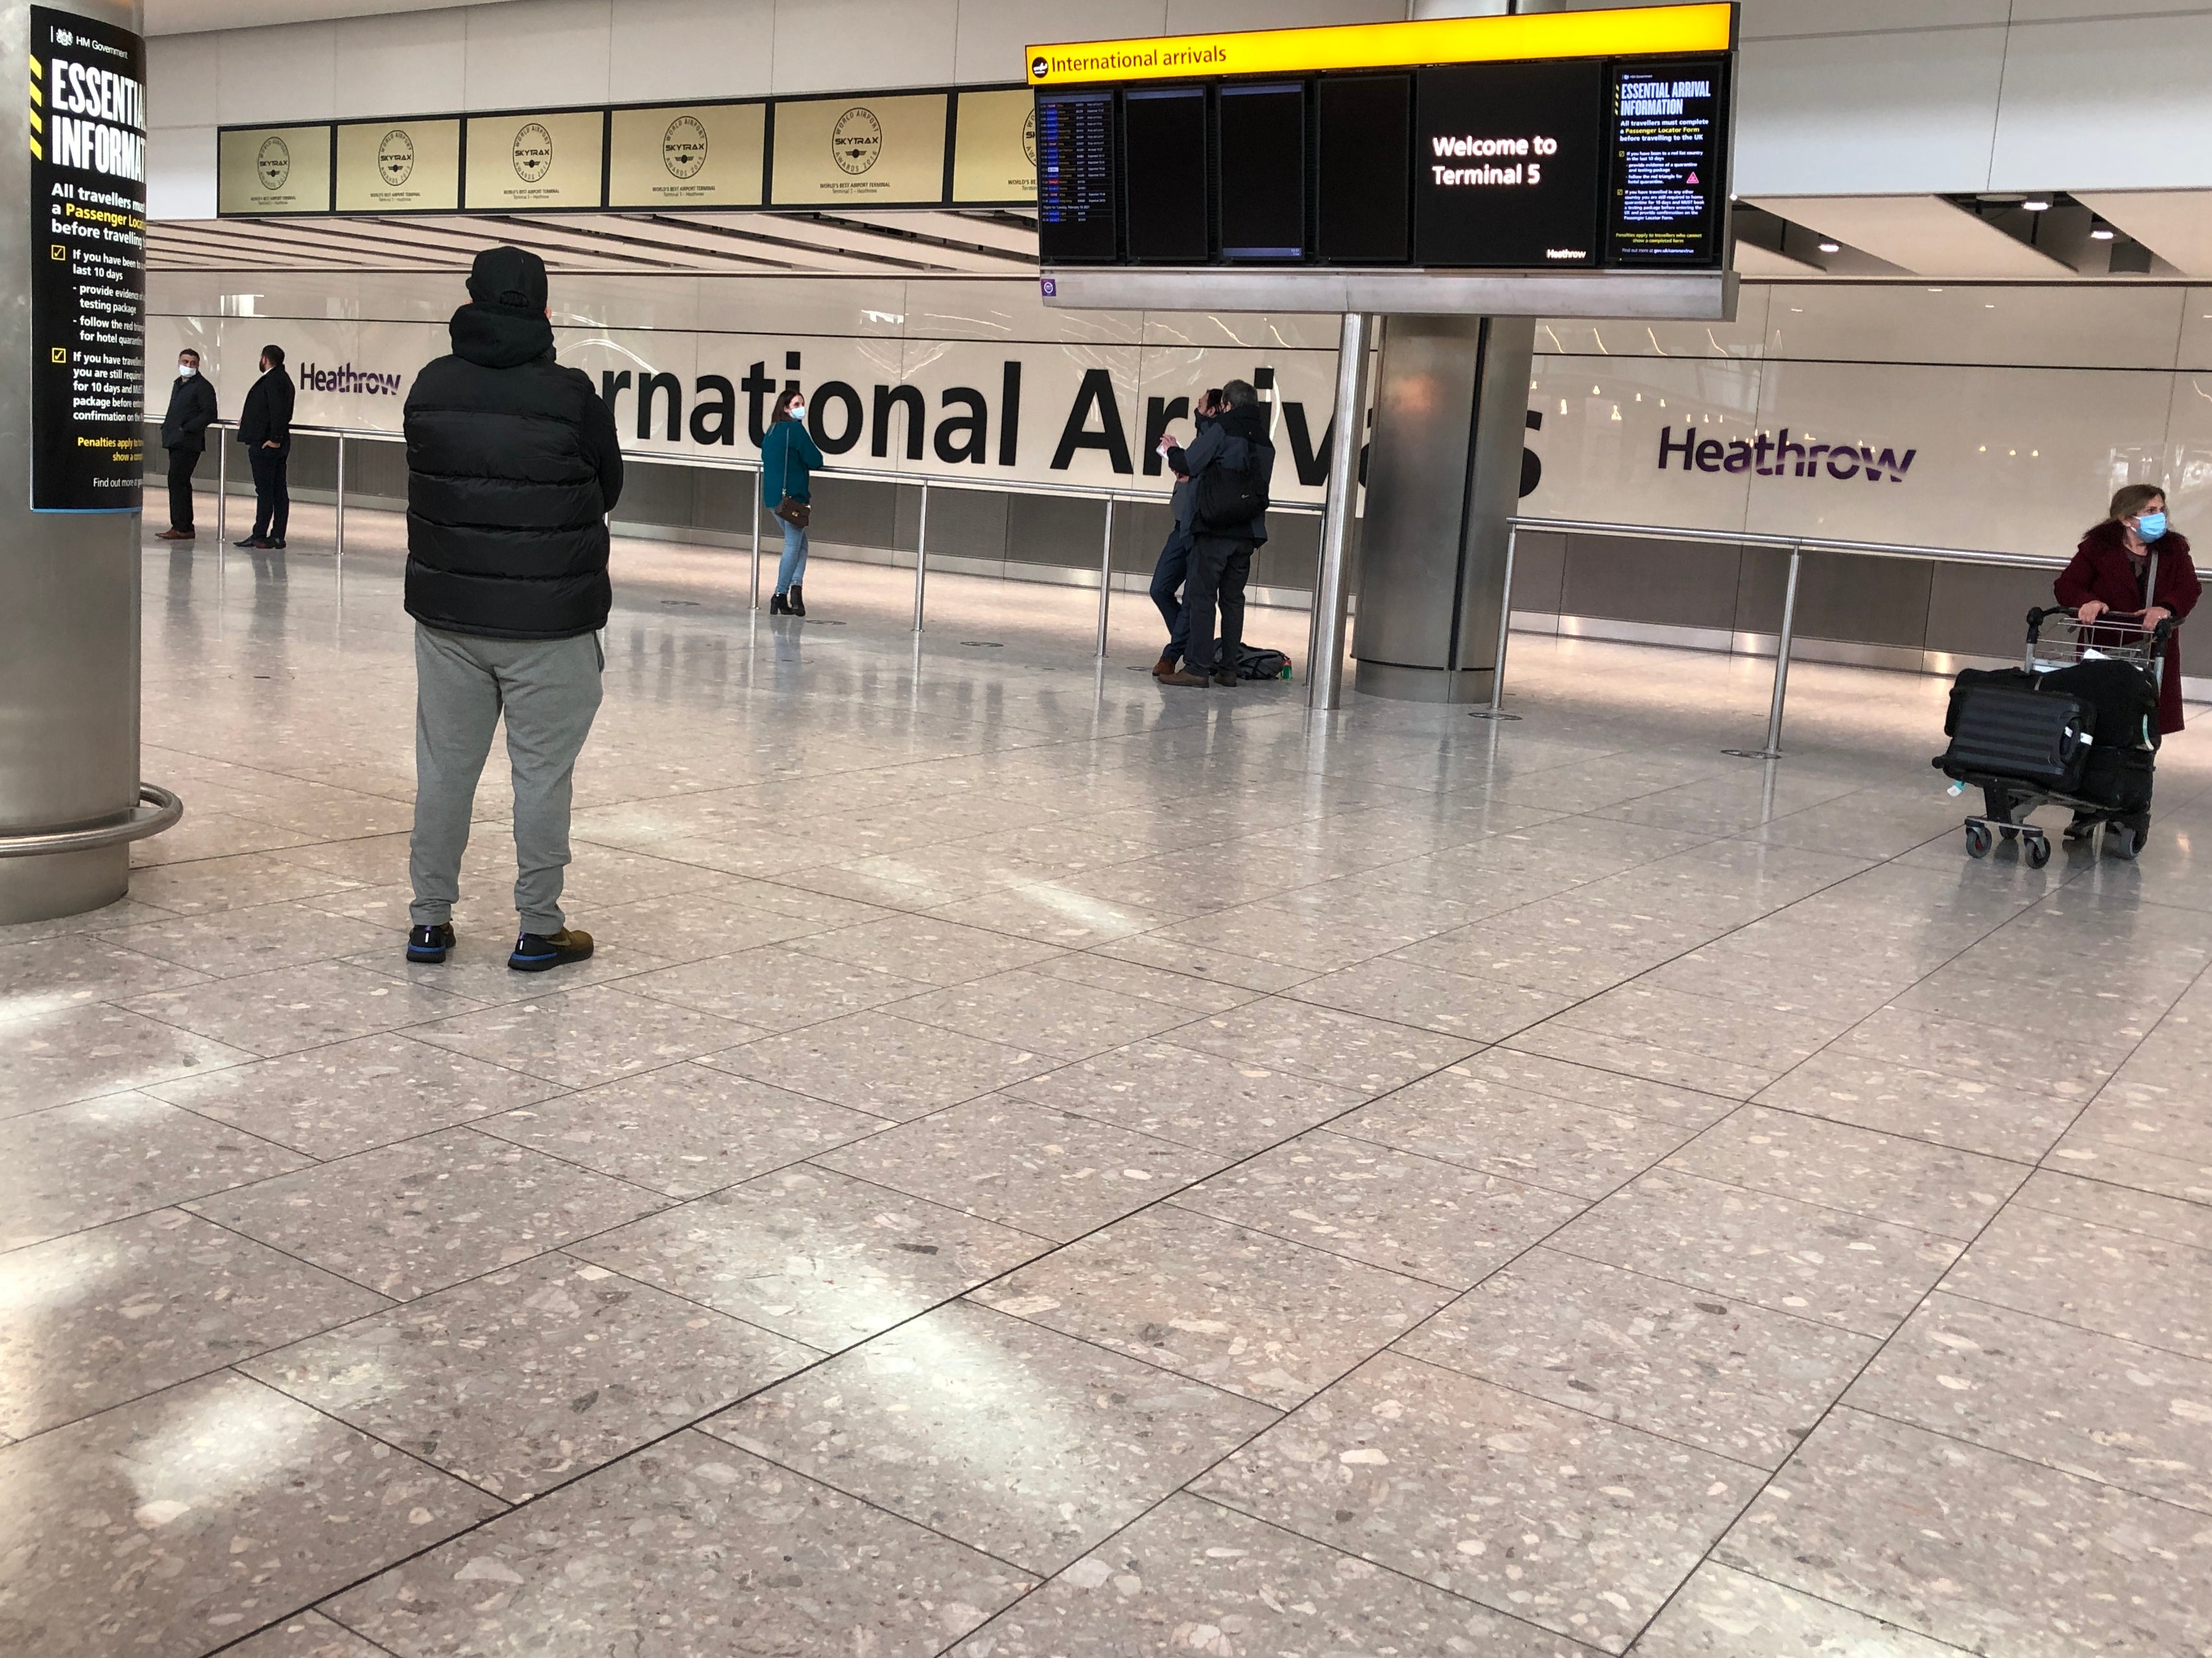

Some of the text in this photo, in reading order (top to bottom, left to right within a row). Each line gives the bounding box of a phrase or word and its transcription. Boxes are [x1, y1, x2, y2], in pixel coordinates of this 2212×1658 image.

[76, 36, 128, 59] HM Government
[1052, 45, 1227, 72] International arrivals
[1621, 80, 1711, 99] ESSENTIAL ARRIVAL
[1621, 99, 1683, 115] INFORMATION
[667, 119, 704, 141] WORLD AIRPORT
[836, 111, 879, 135] WORLD AIRPORT
[1432, 136, 1557, 156] Welcome to
[667, 157, 687, 176] AWARDS
[835, 152, 859, 172] AWARDS
[1432, 163, 1540, 185] Terminal 5
[51, 183, 73, 198] All
[78, 187, 131, 210] travellers
[52, 204, 61, 215] a
[66, 203, 127, 227] Passenger
[52, 218, 143, 250] before travelling
[73, 249, 81, 259] If
[83, 252, 101, 263] you
[103, 253, 121, 265] have
[123, 256, 136, 269] been
[1547, 248, 1586, 258] Heathrow
[73, 263, 123, 282] last 10 days
[80, 285, 113, 296] provide
[115, 289, 139, 300] evidence
[80, 298, 111, 313] testing
[80, 315, 110, 328] follow
[111, 319, 123, 330] the
[124, 322, 133, 331] red
[80, 330, 95, 341] for
[97, 331, 117, 343] hotel
[73, 352, 81, 362] If
[84, 355, 101, 365] you
[103, 354, 121, 365] have
[73, 368, 92, 379] you
[94, 370, 108, 378] are
[110, 369, 123, 379] still
[300, 362, 401, 395] Heathrow
[73, 380, 89, 390] for
[91, 382, 102, 392] 10
[103, 383, 121, 396] days
[121, 384, 132, 394] and
[73, 396, 111, 409] package
[112, 397, 132, 408] before
[73, 410, 126, 422] confirmation
[78, 437, 116, 448] Penalties
[117, 438, 133, 450] apply
[113, 451, 129, 461] show
[1658, 426, 1916, 483] Heathrow
[93, 477, 109, 487] Find
[110, 479, 121, 487] out
